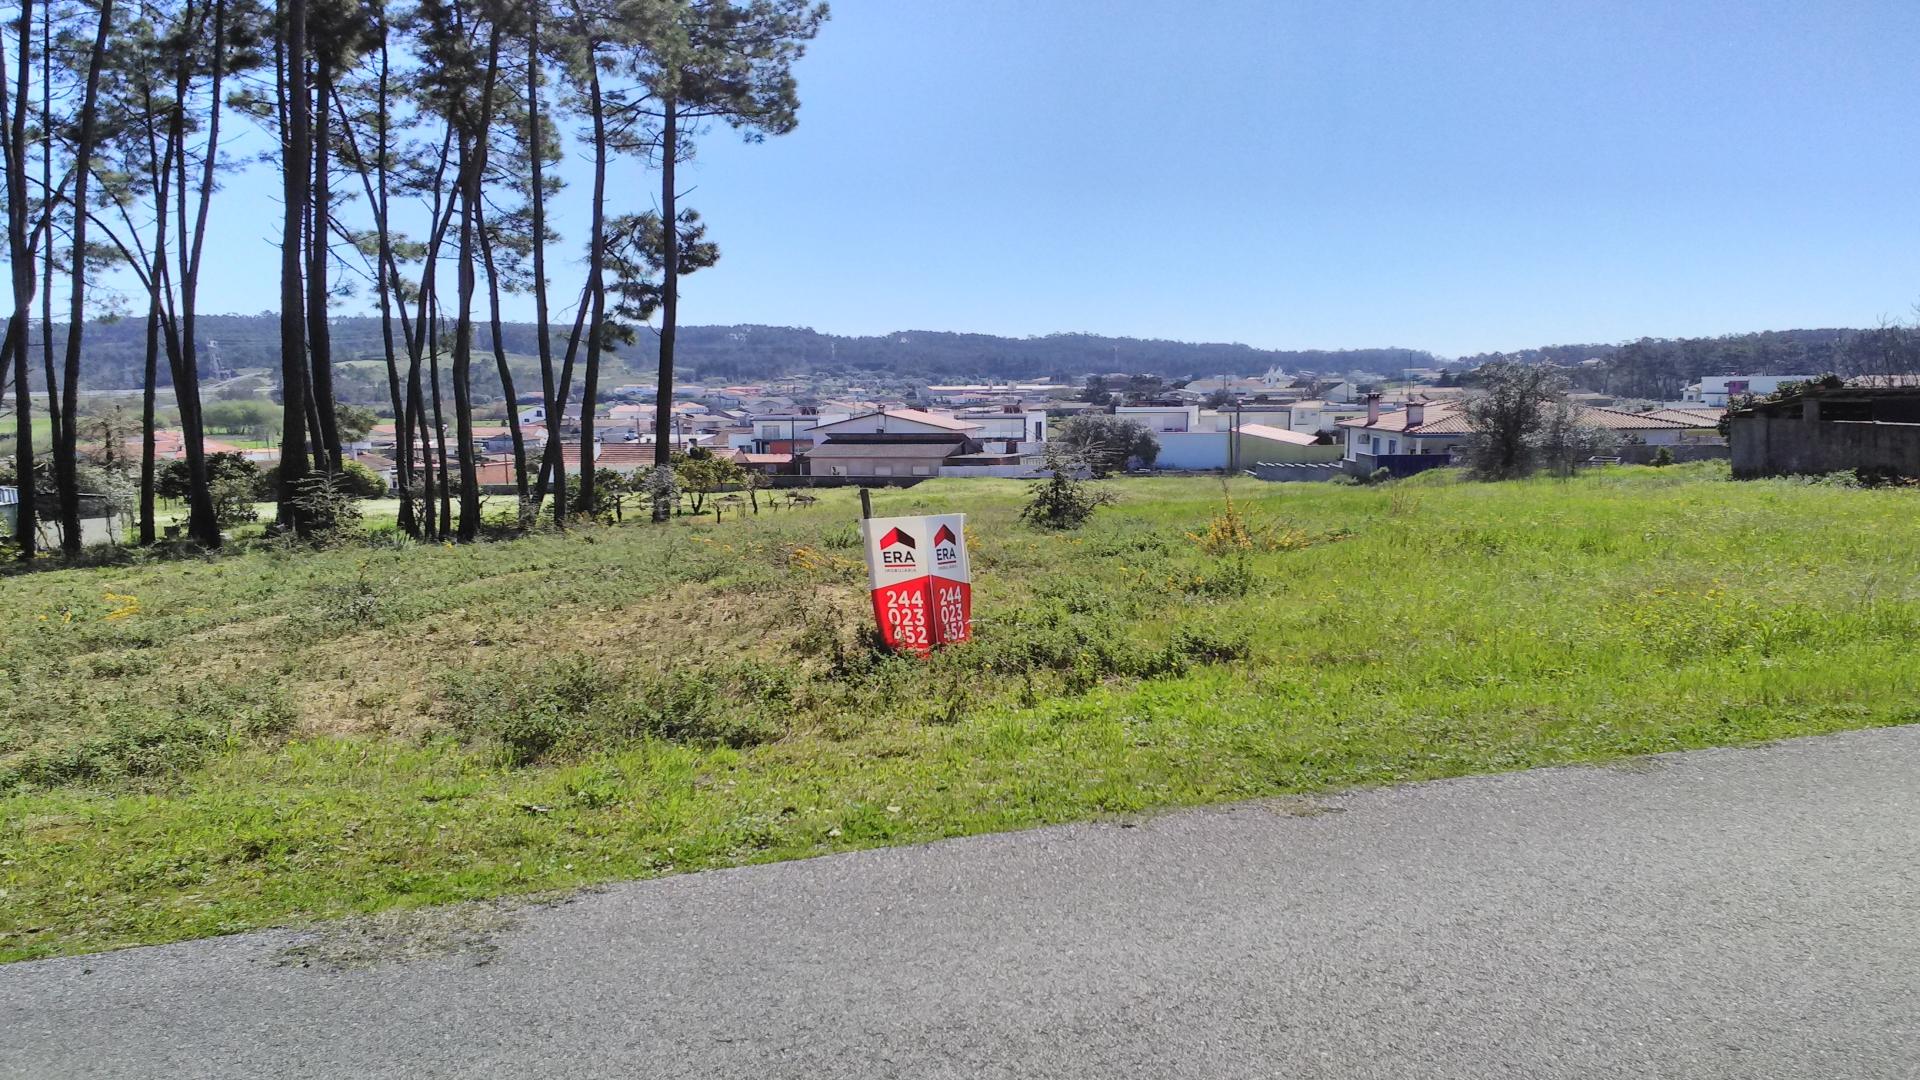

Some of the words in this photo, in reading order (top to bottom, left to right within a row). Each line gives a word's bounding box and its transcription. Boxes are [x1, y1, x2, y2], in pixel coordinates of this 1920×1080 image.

[883, 551, 915, 563] ERA
[936, 548, 956, 561] ERA
[886, 590, 923, 608] 244
[939, 586, 961, 606] 244
[888, 608, 925, 626] 023
[941, 604, 962, 623] 023
